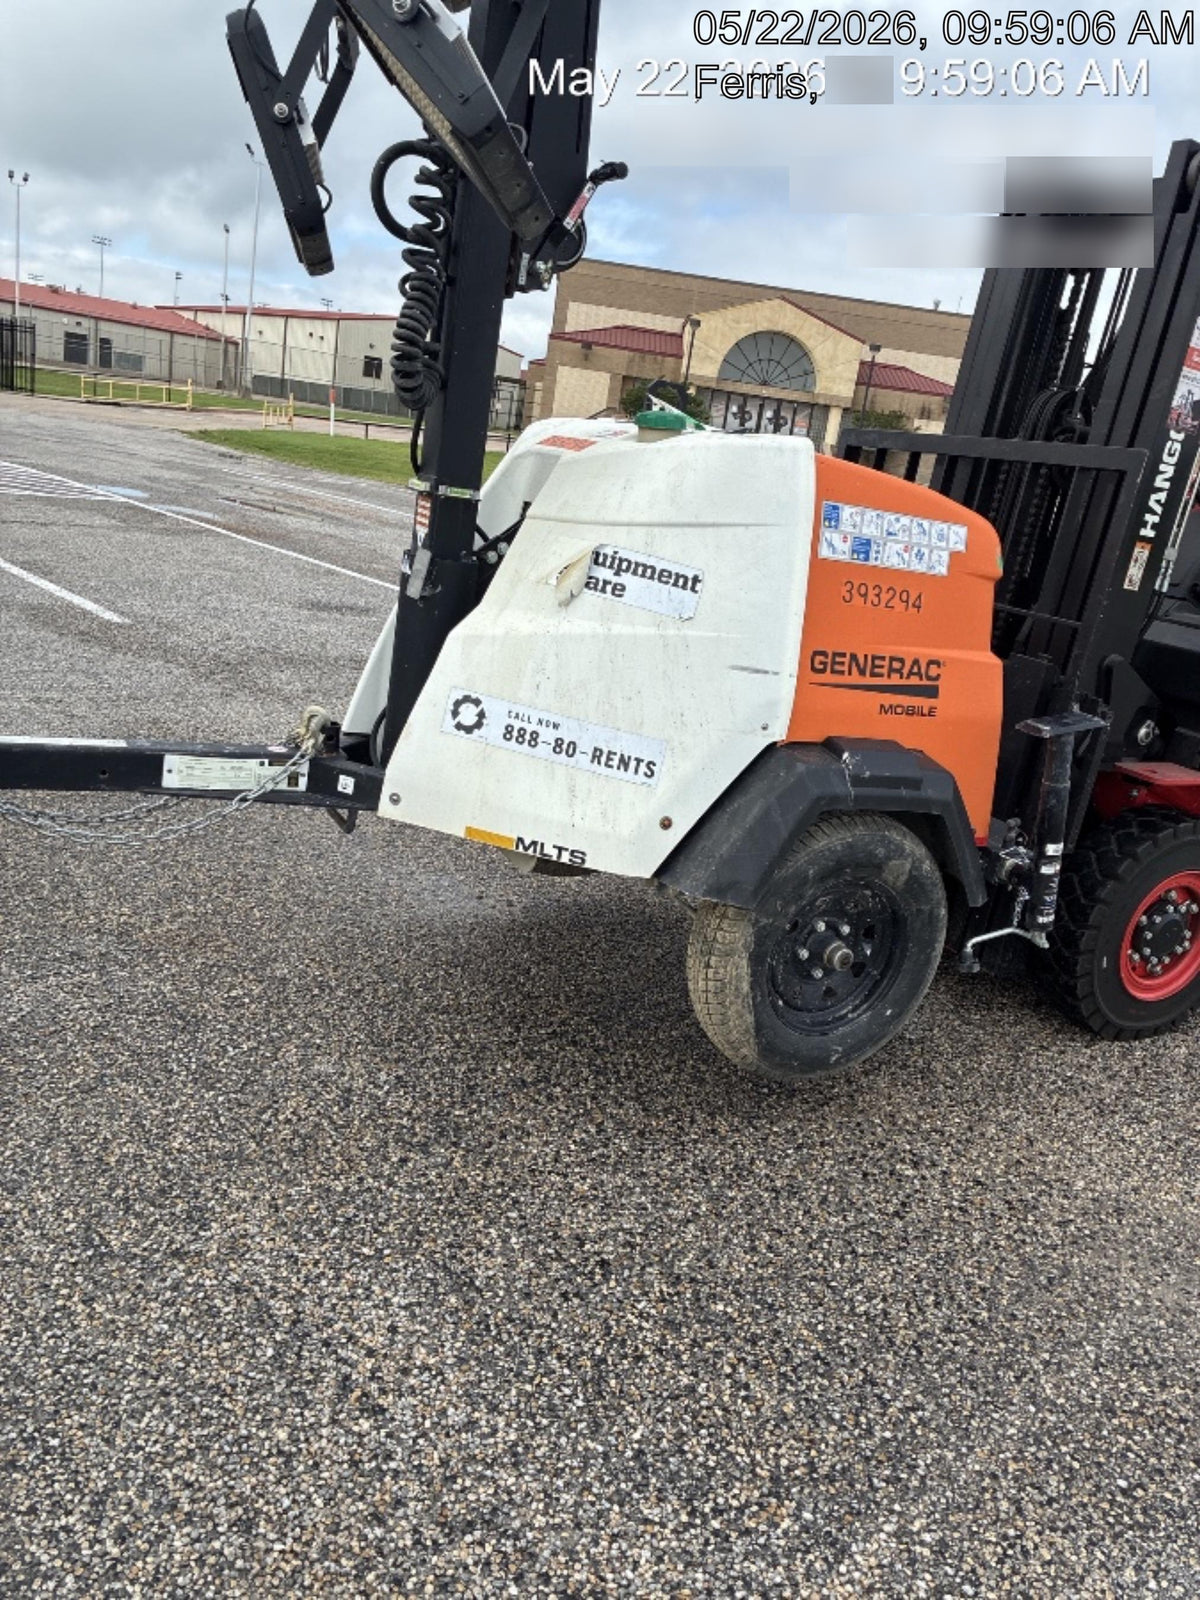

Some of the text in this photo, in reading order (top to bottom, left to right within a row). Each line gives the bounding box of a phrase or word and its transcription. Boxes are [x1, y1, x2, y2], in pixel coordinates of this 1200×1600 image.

[584, 574, 627, 598] are
[592, 550, 703, 594] uipment
[842, 580, 923, 614] 393294
[810, 650, 942, 682] GENERAC
[507, 710, 561, 731] CALL NOW
[879, 704, 937, 717] MOBILE
[502, 724, 657, 779] 888-80-RENTS
[515, 836, 588, 867] MLTS
